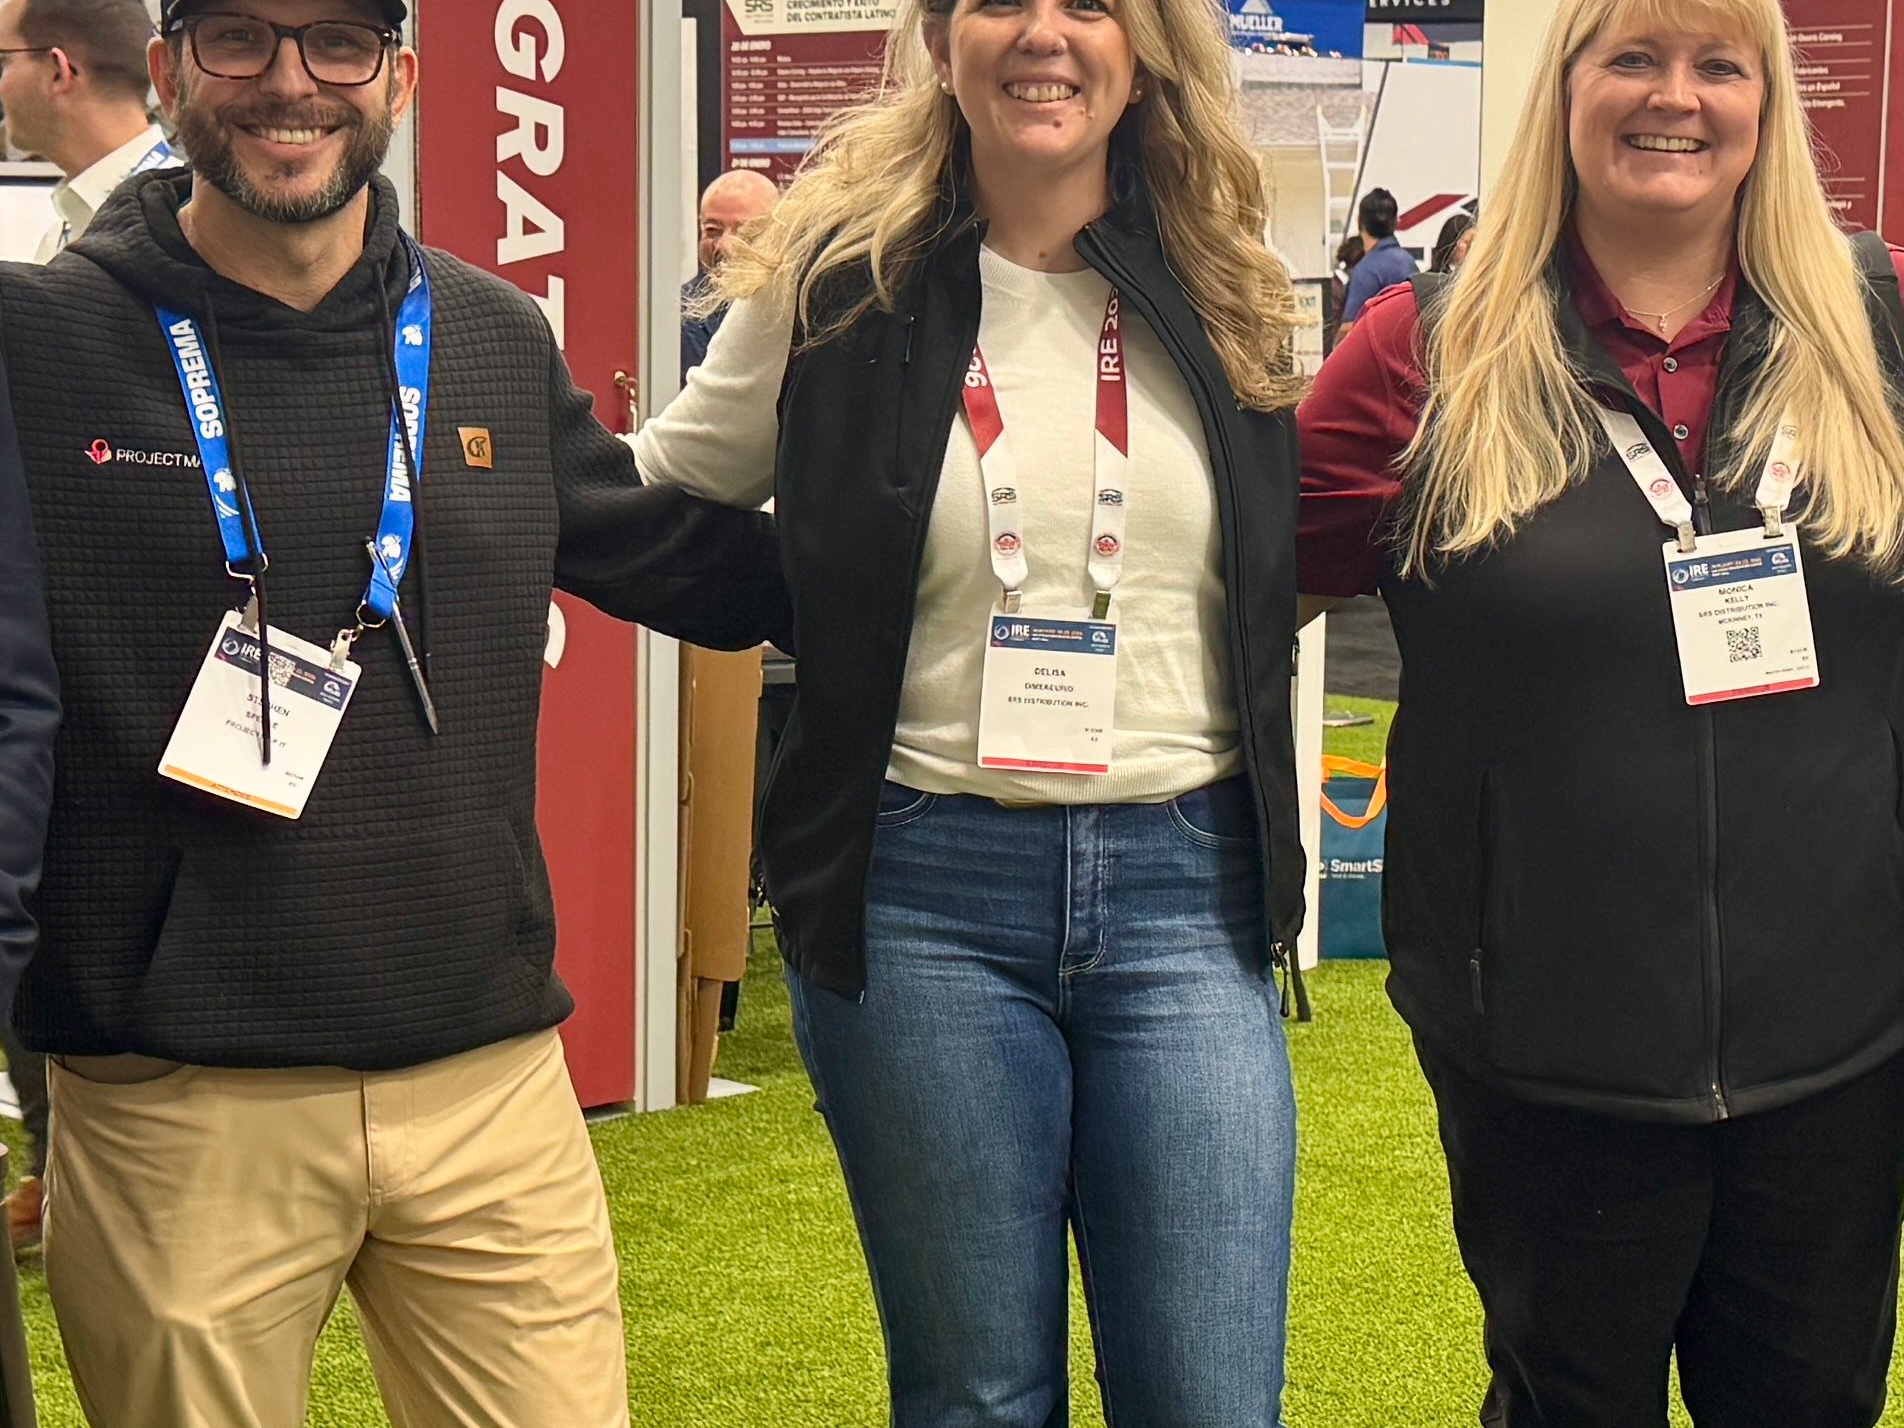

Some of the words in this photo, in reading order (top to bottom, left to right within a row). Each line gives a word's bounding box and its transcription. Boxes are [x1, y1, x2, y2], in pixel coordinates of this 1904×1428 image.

[1228, 13, 1282, 32] MUELLER
[1100, 337, 1121, 381] IRE
[169, 319, 224, 439] SOPREMA
[1689, 562, 1709, 578] IRE
[1011, 624, 1030, 636] IRE
